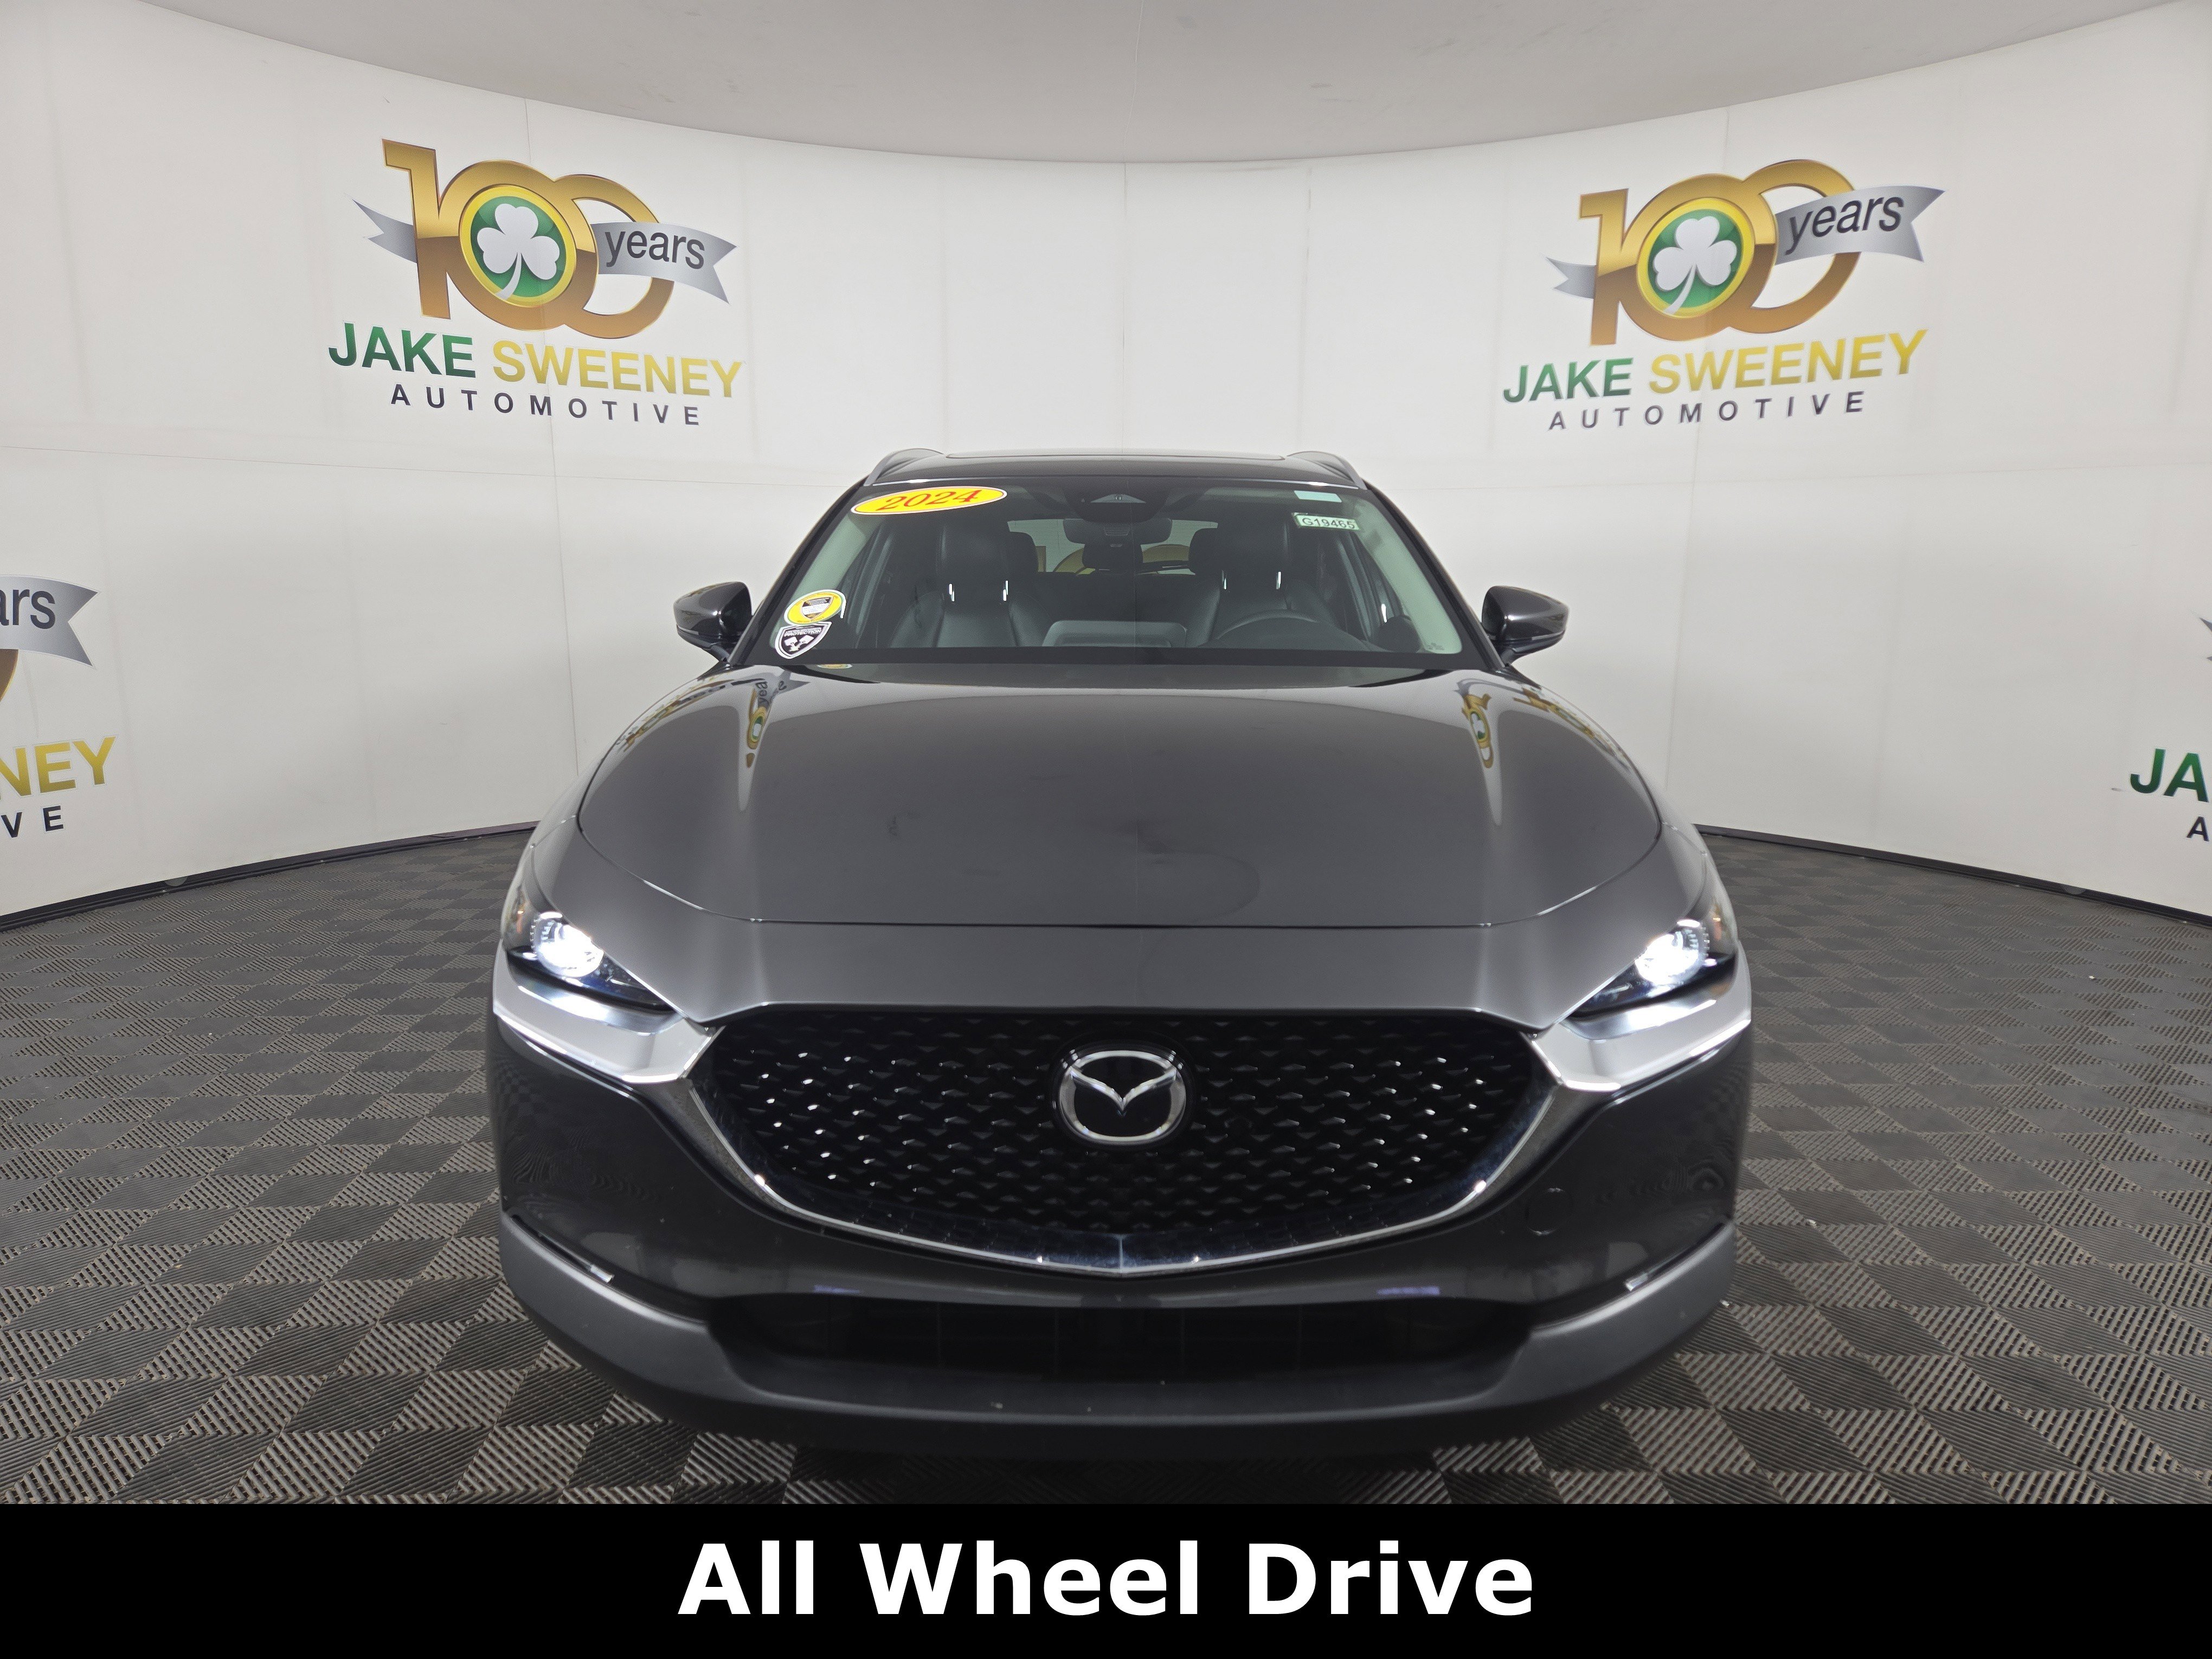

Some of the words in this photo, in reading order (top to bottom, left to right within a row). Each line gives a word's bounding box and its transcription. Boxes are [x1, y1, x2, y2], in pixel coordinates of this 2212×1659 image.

[1785, 196, 1905, 256] years
[605, 229, 705, 269] years
[328, 322, 477, 378] JAKE
[492, 340, 743, 397] SWEENEY
[1502, 357, 1634, 403] JAKE
[1649, 329, 1928, 395] SWEENEY
[390, 383, 700, 426] AUTOMOTIVE
[1548, 391, 1864, 431] AUTOMOTIVE
[876, 490, 982, 511] 2024
[1302, 517, 1355, 529] G19465
